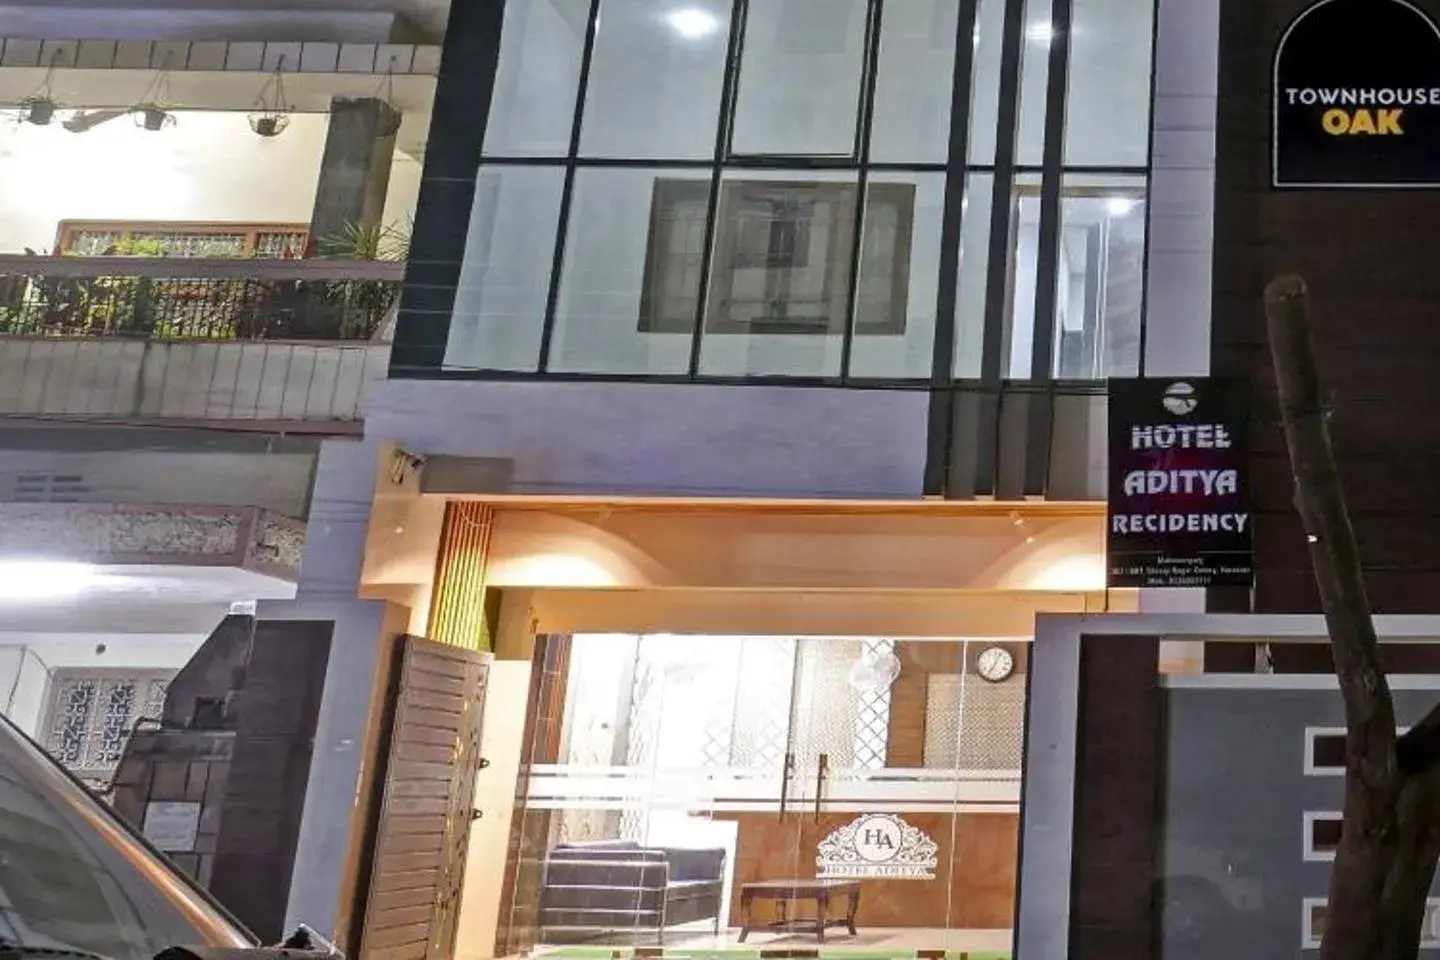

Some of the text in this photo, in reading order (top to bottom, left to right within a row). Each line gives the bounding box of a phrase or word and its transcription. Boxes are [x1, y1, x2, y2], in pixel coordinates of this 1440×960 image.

[1322, 108, 1404, 135] OAK
[1131, 424, 1232, 449] HOTEL
[1124, 469, 1238, 496] ADITYA
[1112, 514, 1248, 533] RECIDENCY
